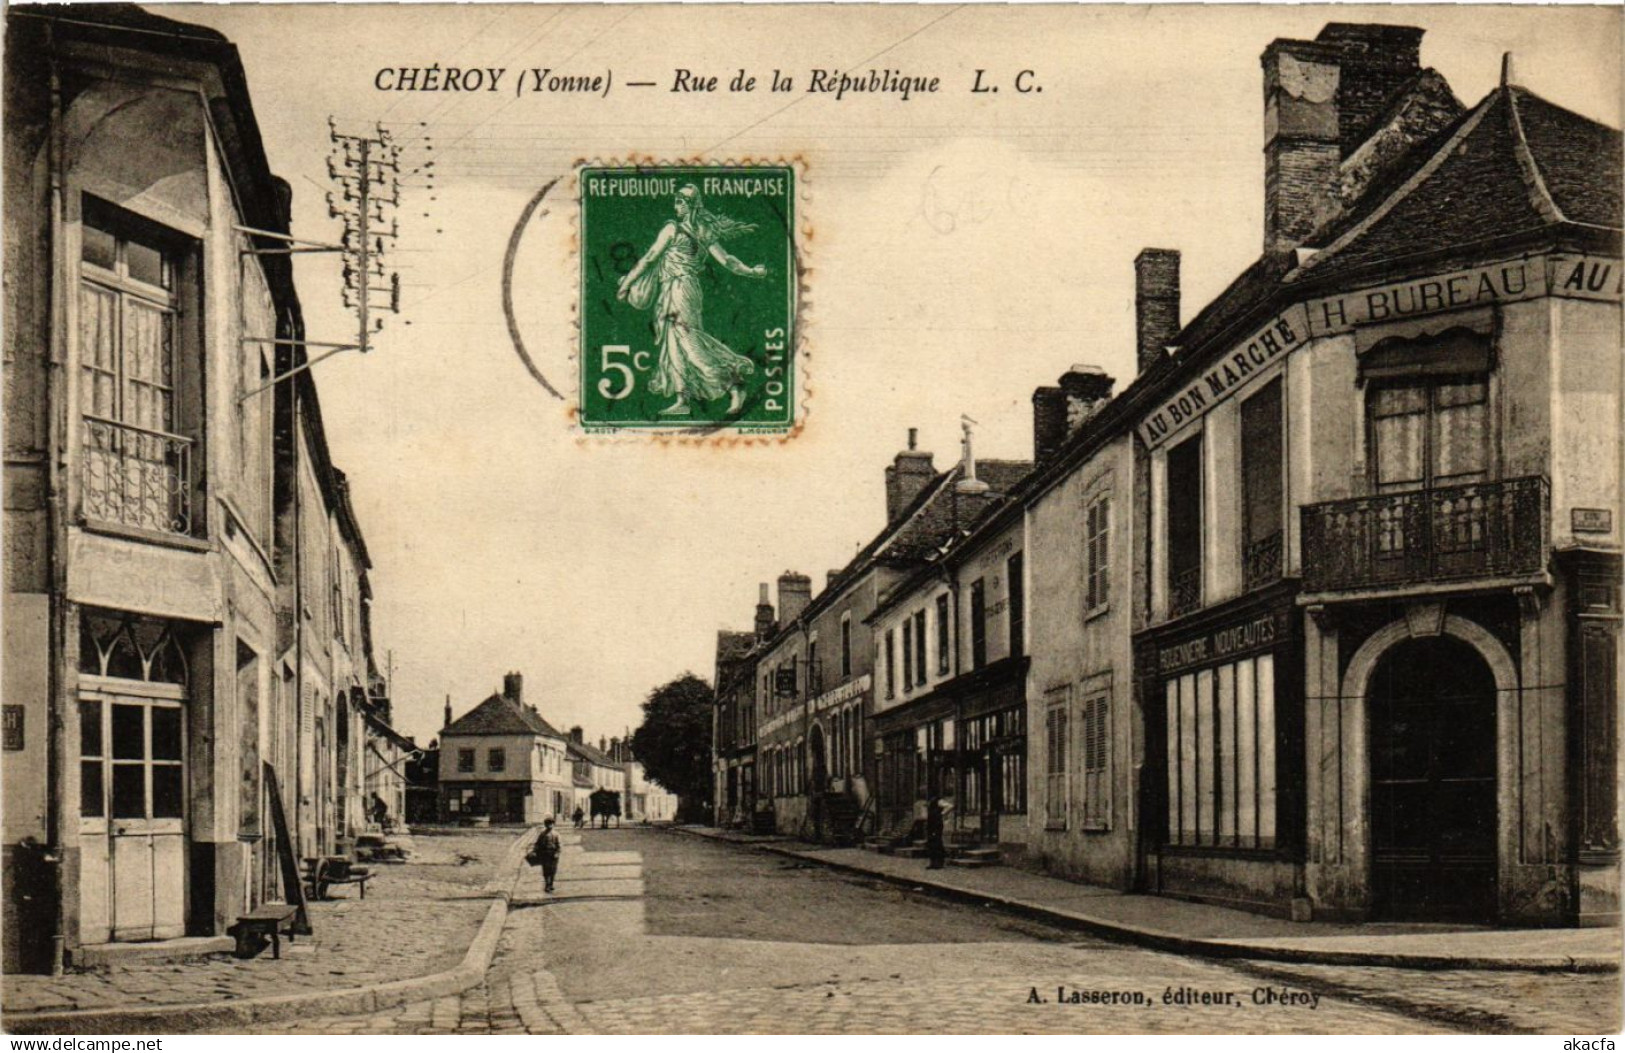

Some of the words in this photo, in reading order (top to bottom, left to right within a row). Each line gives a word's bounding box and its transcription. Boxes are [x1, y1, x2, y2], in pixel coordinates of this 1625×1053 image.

[704, 178, 784, 198] FRANÇAISE
[1366, 265, 1527, 321] BUREAU
[1564, 261, 1611, 292] AU
[764, 327, 784, 411] POSTES
[1146, 413, 1168, 442] AU
[1167, 385, 1206, 425] BON
